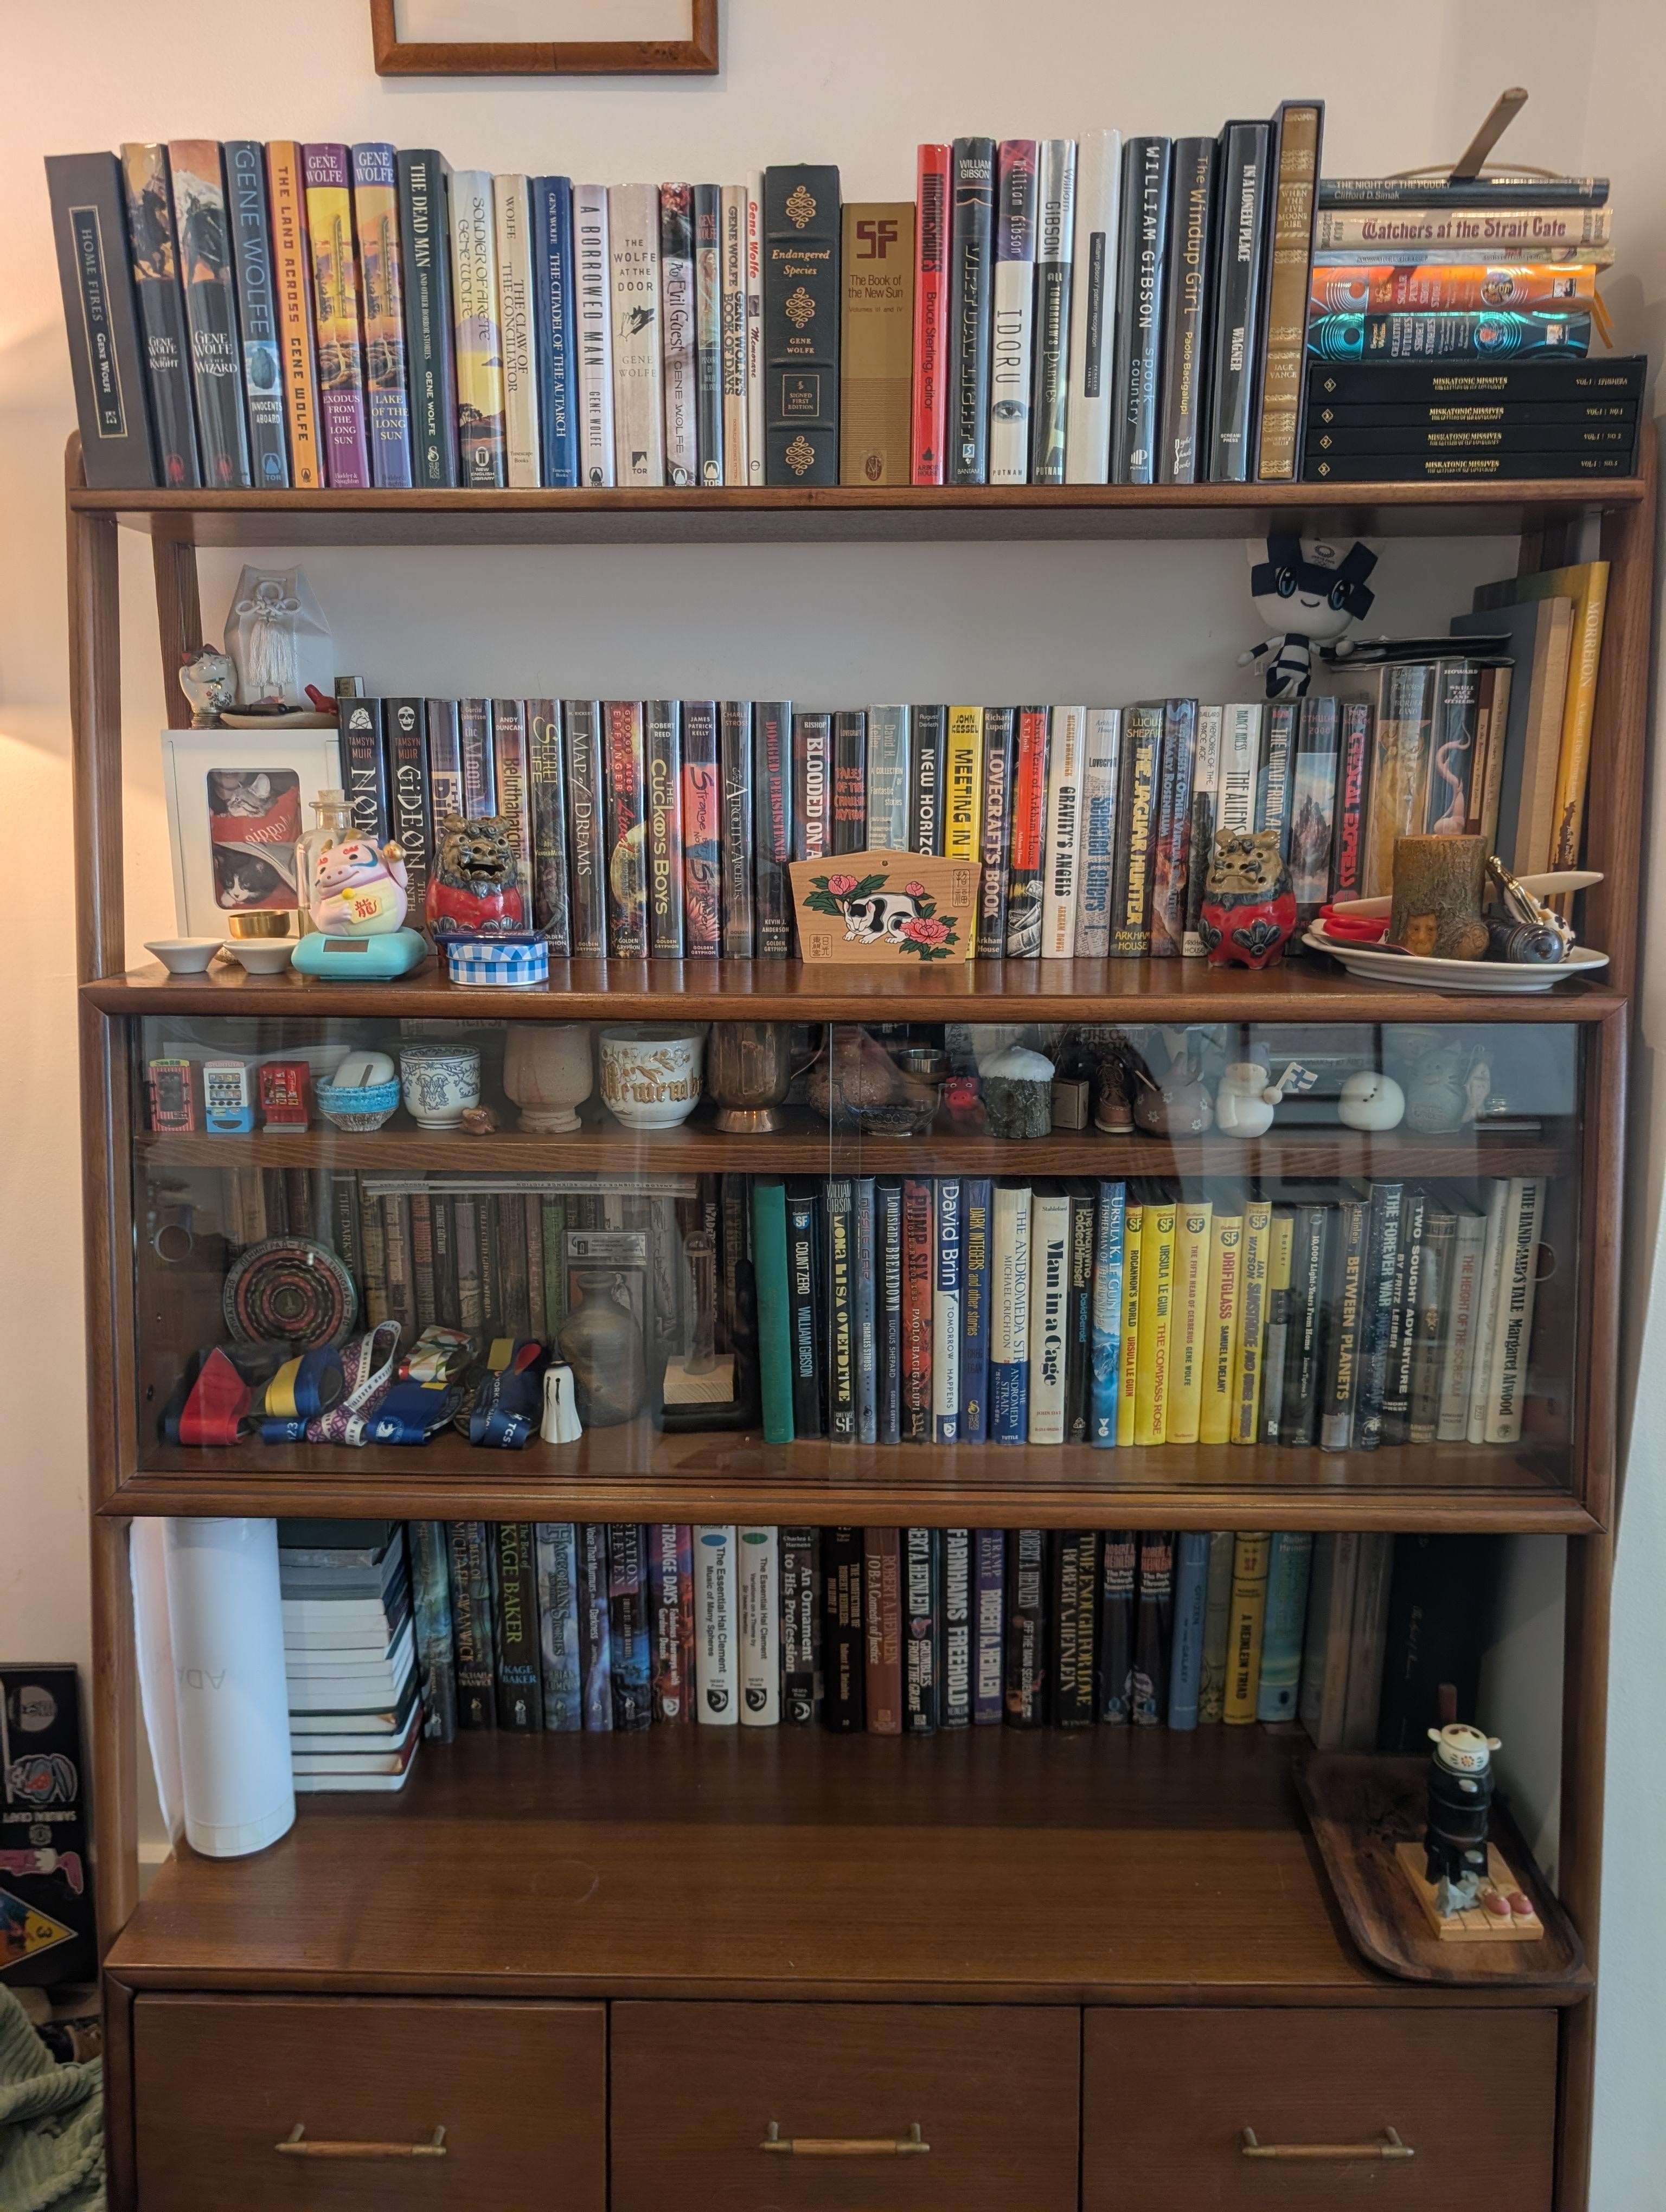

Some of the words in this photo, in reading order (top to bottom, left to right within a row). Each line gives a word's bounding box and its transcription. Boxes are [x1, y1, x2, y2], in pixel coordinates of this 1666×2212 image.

[309, 157, 338, 169] GENE
[357, 166, 394, 182] WOLFE
[359, 152, 390, 166] GENE
[959, 160, 991, 169] WILLIAM
[960, 169, 989, 179] GIBSON
[1197, 156, 1208, 184] The
[234, 150, 260, 226] GENE
[278, 167, 290, 197] THE
[307, 169, 342, 183] WOLFE
[410, 163, 425, 191] THE
[1145, 146, 1160, 241] WILLIAM
[1335, 190, 1364, 200] Clifford
[1376, 191, 1400, 200] Simak
[281, 206, 293, 249] LAND
[412, 195, 428, 232] DEAD
[505, 197, 516, 240] WOLFE
[749, 202, 758, 236] Gene
[1043, 201, 1060, 256] GIBSON
[1183, 189, 1207, 265] Windup
[1362, 218, 1433, 240] Watchers
[1437, 223, 1453, 239] at
[1456, 221, 1479, 238] the
[1484, 217, 1528, 237] Strait
[1533, 217, 1566, 237] Gate
[82, 229, 97, 275] HOME
[414, 234, 430, 268] MAN
[772, 250, 830, 261] Endangered
[856, 220, 897, 260] SF
[581, 226, 603, 319] BORROWED
[613, 253, 657, 262] WOLFE
[749, 240, 759, 279] Wolfe
[783, 265, 817, 276] Species
[241, 239, 270, 333] WOLFE
[285, 259, 299, 322] ACROSS
[502, 261, 513, 293] THE
[618, 281, 653, 291] DOOR
[848, 287, 862, 298] the
[864, 287, 884, 298] New
[886, 287, 903, 298] Sun
[850, 275, 867, 286] The
[868, 275, 889, 286] Book
[891, 275, 901, 286] of
[1139, 249, 1155, 328] GIBSON
[1184, 269, 1204, 313] Girl
[88, 281, 102, 321] FIRES
[514, 279, 525, 309] THE
[925, 291, 937, 324] Bruce
[504, 295, 518, 393] CONCILIATOR
[515, 312, 527, 352] CLAW
[996, 310, 1022, 383] IDORU
[1183, 331, 1193, 360] Paolo
[291, 338, 304, 379] GENE
[584, 331, 604, 366] MAN
[622, 356, 652, 364] GENE
[925, 327, 937, 373] Sterling,
[517, 355, 528, 374] OF
[619, 369, 657, 377] WOLFE
[323, 395, 360, 403] EXODUS
[375, 396, 403, 404] LAKE
[589, 391, 600, 415] GENE
[925, 377, 933, 411] editor
[1127, 359, 1140, 425] country
[1180, 363, 1191, 415] Bacigalupi
[251, 401, 282, 411] INNOCENTS
[257, 413, 280, 423] ABOARD
[295, 390, 307, 441] WOLFE
[329, 406, 355, 414] FROM
[372, 408, 386, 416] OF
[388, 408, 408, 416] THE
[427, 400, 436, 435] WOLFE
[376, 420, 406, 429] LONG
[381, 431, 402, 440] SUN
[590, 417, 601, 447] WOLFE
[1579, 602, 1600, 688] MORREION
[349, 737, 374, 746] TAMSYN
[353, 749, 371, 758] MUIR
[395, 737, 421, 746] TAMSYN
[399, 749, 418, 758] MUIR
[572, 732, 588, 774] MAP
[572, 776, 592, 796] of
[806, 738, 823, 818] BLOODED
[576, 802, 592, 876] DREAMS
[806, 822, 823, 845] ON
[953, 829, 971, 847] IN
[984, 870, 1000, 919] BOOK
[1116, 931, 1150, 940] ARKHAM
[1119, 942, 1147, 950] HOUSE
[886, 1197, 898, 1245] Louisiana
[942, 1186, 959, 1240] David
[796, 1242, 809, 1271] COUNT
[942, 1249, 958, 1285] Brin
[1046, 1239, 1063, 1288] Man
[1160, 1245, 1170, 1278] URSULA
[797, 1273, 810, 1294] ZERO
[886, 1247, 900, 1311] BREAKDOWN
[1158, 1283, 1169, 1294] LE
[1219, 1252, 1235, 1320] DRIFTGLASS
[1343, 1257, 1360, 1327] BETWEEN
[1046, 1293, 1062, 1315] in
[1127, 1301, 1137, 1328] WORLD
[1157, 1296, 1168, 1316] GUIN
[798, 1306, 811, 1343] WILLIAM
[1046, 1318, 1058, 1332] a
[1157, 1323, 1165, 1347] THE
[798, 1345, 812, 1377] GIBSON
[1041, 1335, 1061, 1387] Cage
[1126, 1336, 1136, 1366] URSULA
[1126, 1368, 1134, 1377] LE
[1154, 1348, 1165, 1402] COMPASS
[1336, 1334, 1354, 1401] PLANETS
[1125, 1380, 1133, 1397] GUIN
[1152, 1404, 1162, 1436] ROSE
[716, 1546, 726, 1567] The
[716, 1570, 726, 1612] Essential
[504, 1583, 524, 1644] BAKER
[716, 1614, 726, 1629] Hal
[717, 1631, 727, 1674] Clement
[947, 1625, 969, 1706] FREEHOLD
